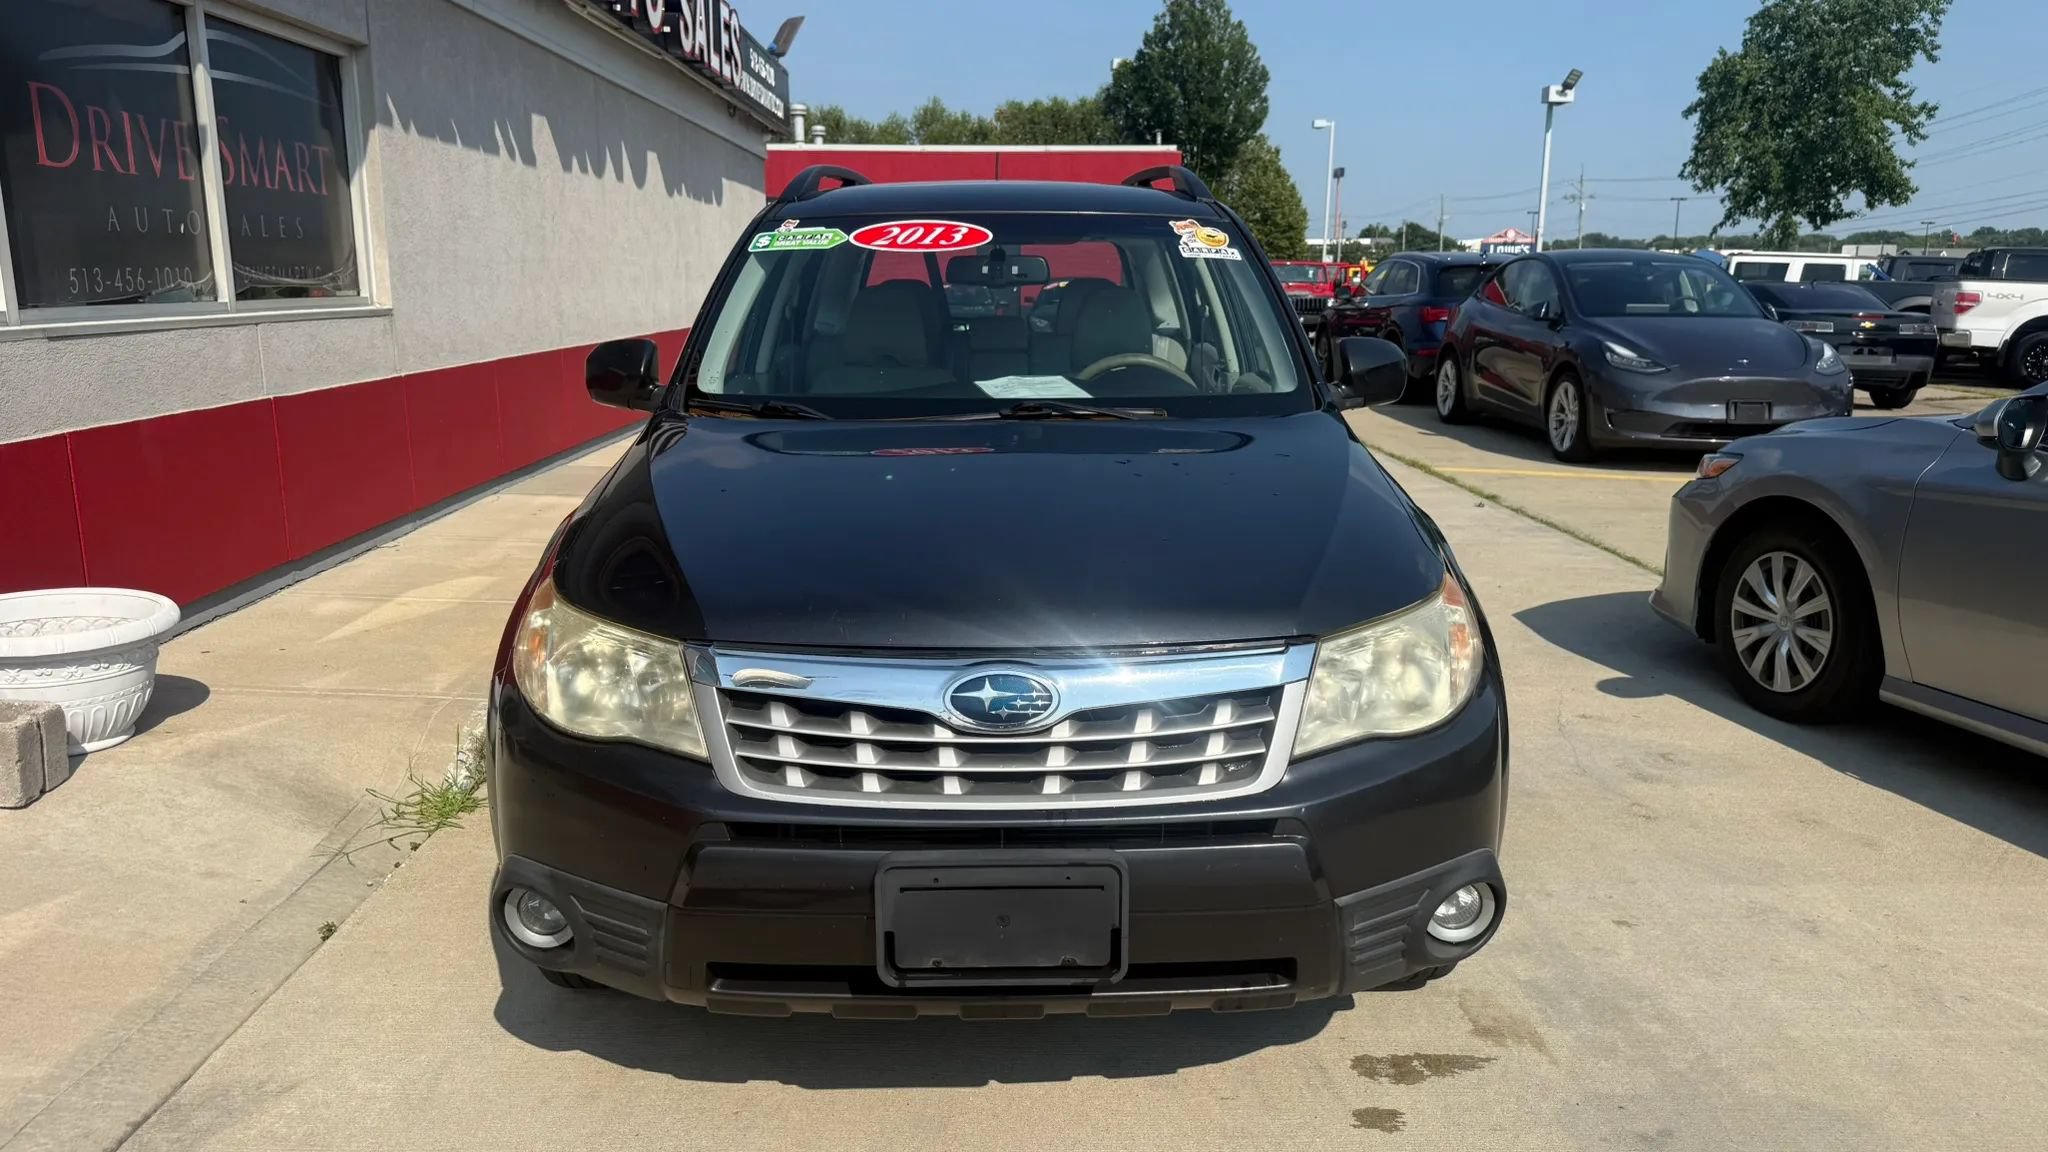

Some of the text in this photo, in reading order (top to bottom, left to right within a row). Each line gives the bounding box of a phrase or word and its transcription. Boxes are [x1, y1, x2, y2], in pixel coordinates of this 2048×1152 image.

[680, 0, 743, 90] SALES
[107, 205, 304, 240] AUTO ALES
[870, 226, 969, 246] 2013
